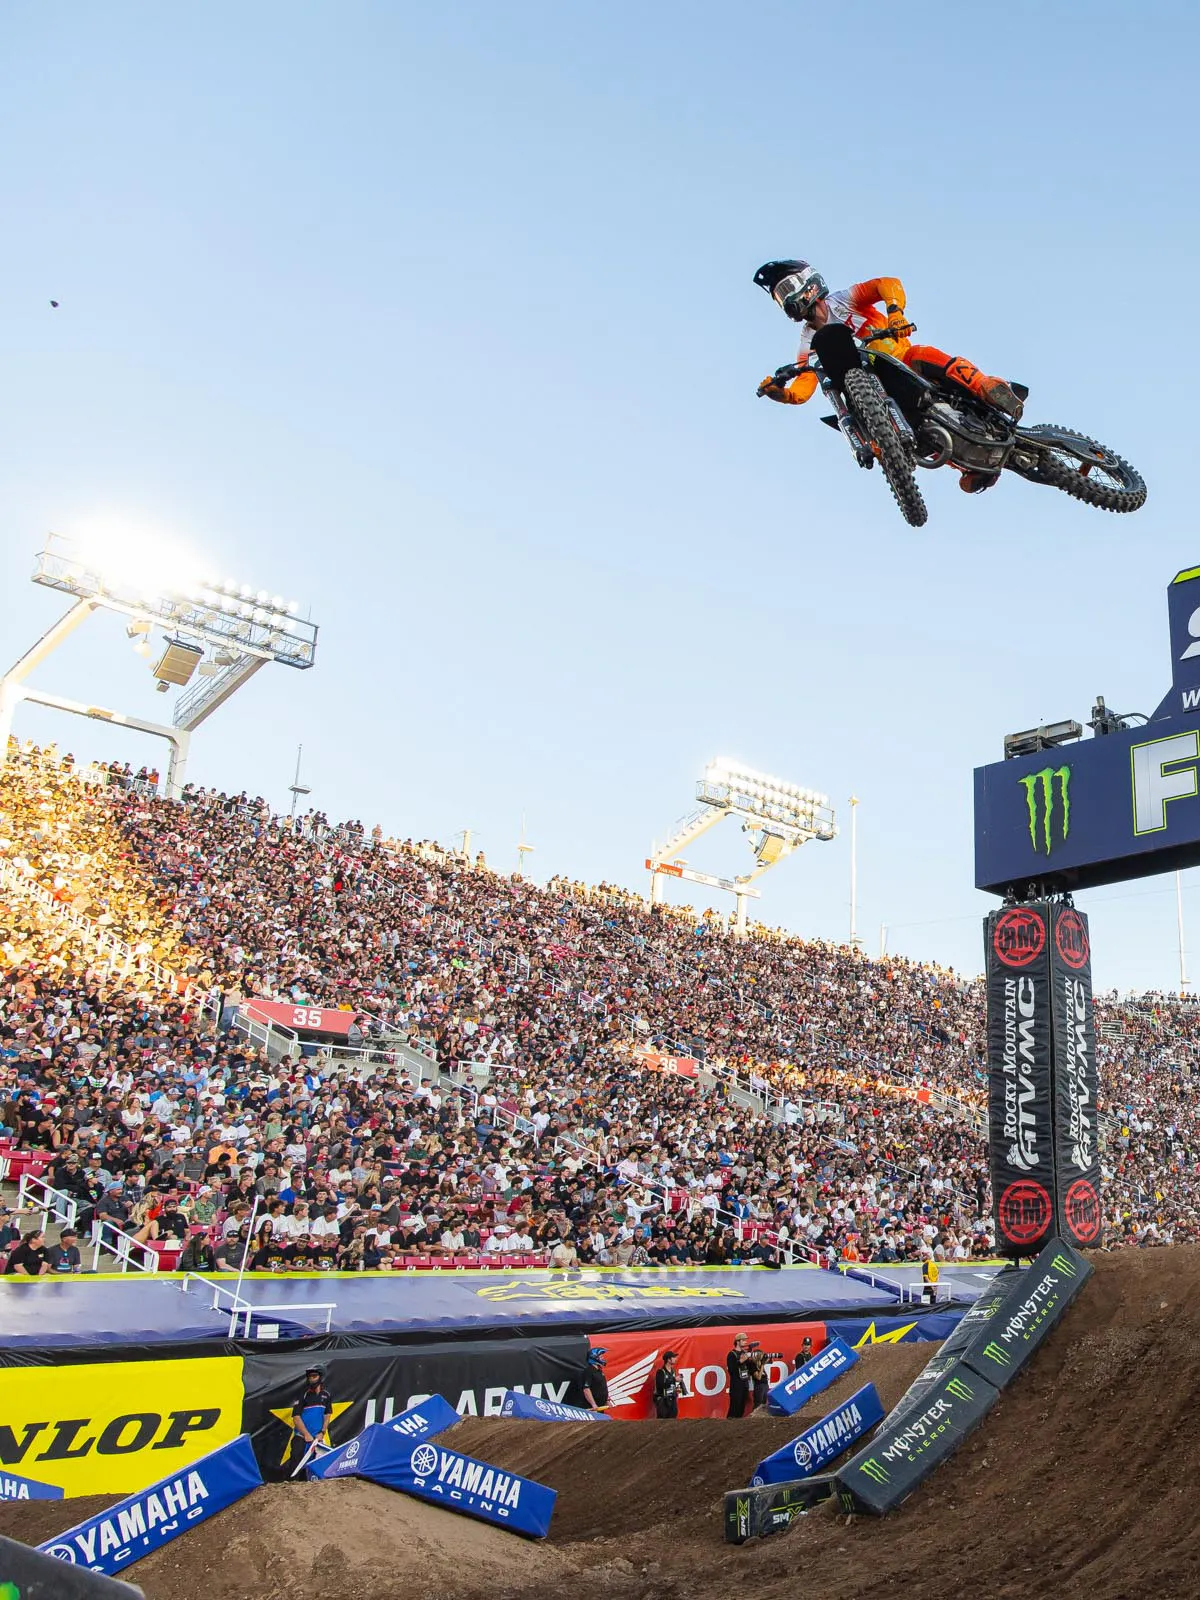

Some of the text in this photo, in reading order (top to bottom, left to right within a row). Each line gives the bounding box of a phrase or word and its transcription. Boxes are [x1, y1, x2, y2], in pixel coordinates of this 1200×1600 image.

[292, 1008, 322, 1028] 35
[660, 1056, 678, 1072] 36
[1003, 977, 1018, 1140] ROCKY MOUNTAIN
[1065, 976, 1081, 1140] ROCKY MOUNTAIN
[1000, 1274, 1059, 1343] MONSTER
[1023, 1293, 1060, 1341] ENERGY
[784, 1348, 843, 1396] FALKEN
[549, 1402, 595, 1421] YAMAHA
[807, 1403, 862, 1455] YAMAHA
[882, 1399, 953, 1462] MONSTER
[805, 1426, 862, 1471] RACING
[908, 1418, 953, 1463] ENERGY
[413, 1478, 510, 1518] RACING
[438, 1452, 522, 1509] YAMAHA
[75, 1470, 209, 1564] YAMAHA
